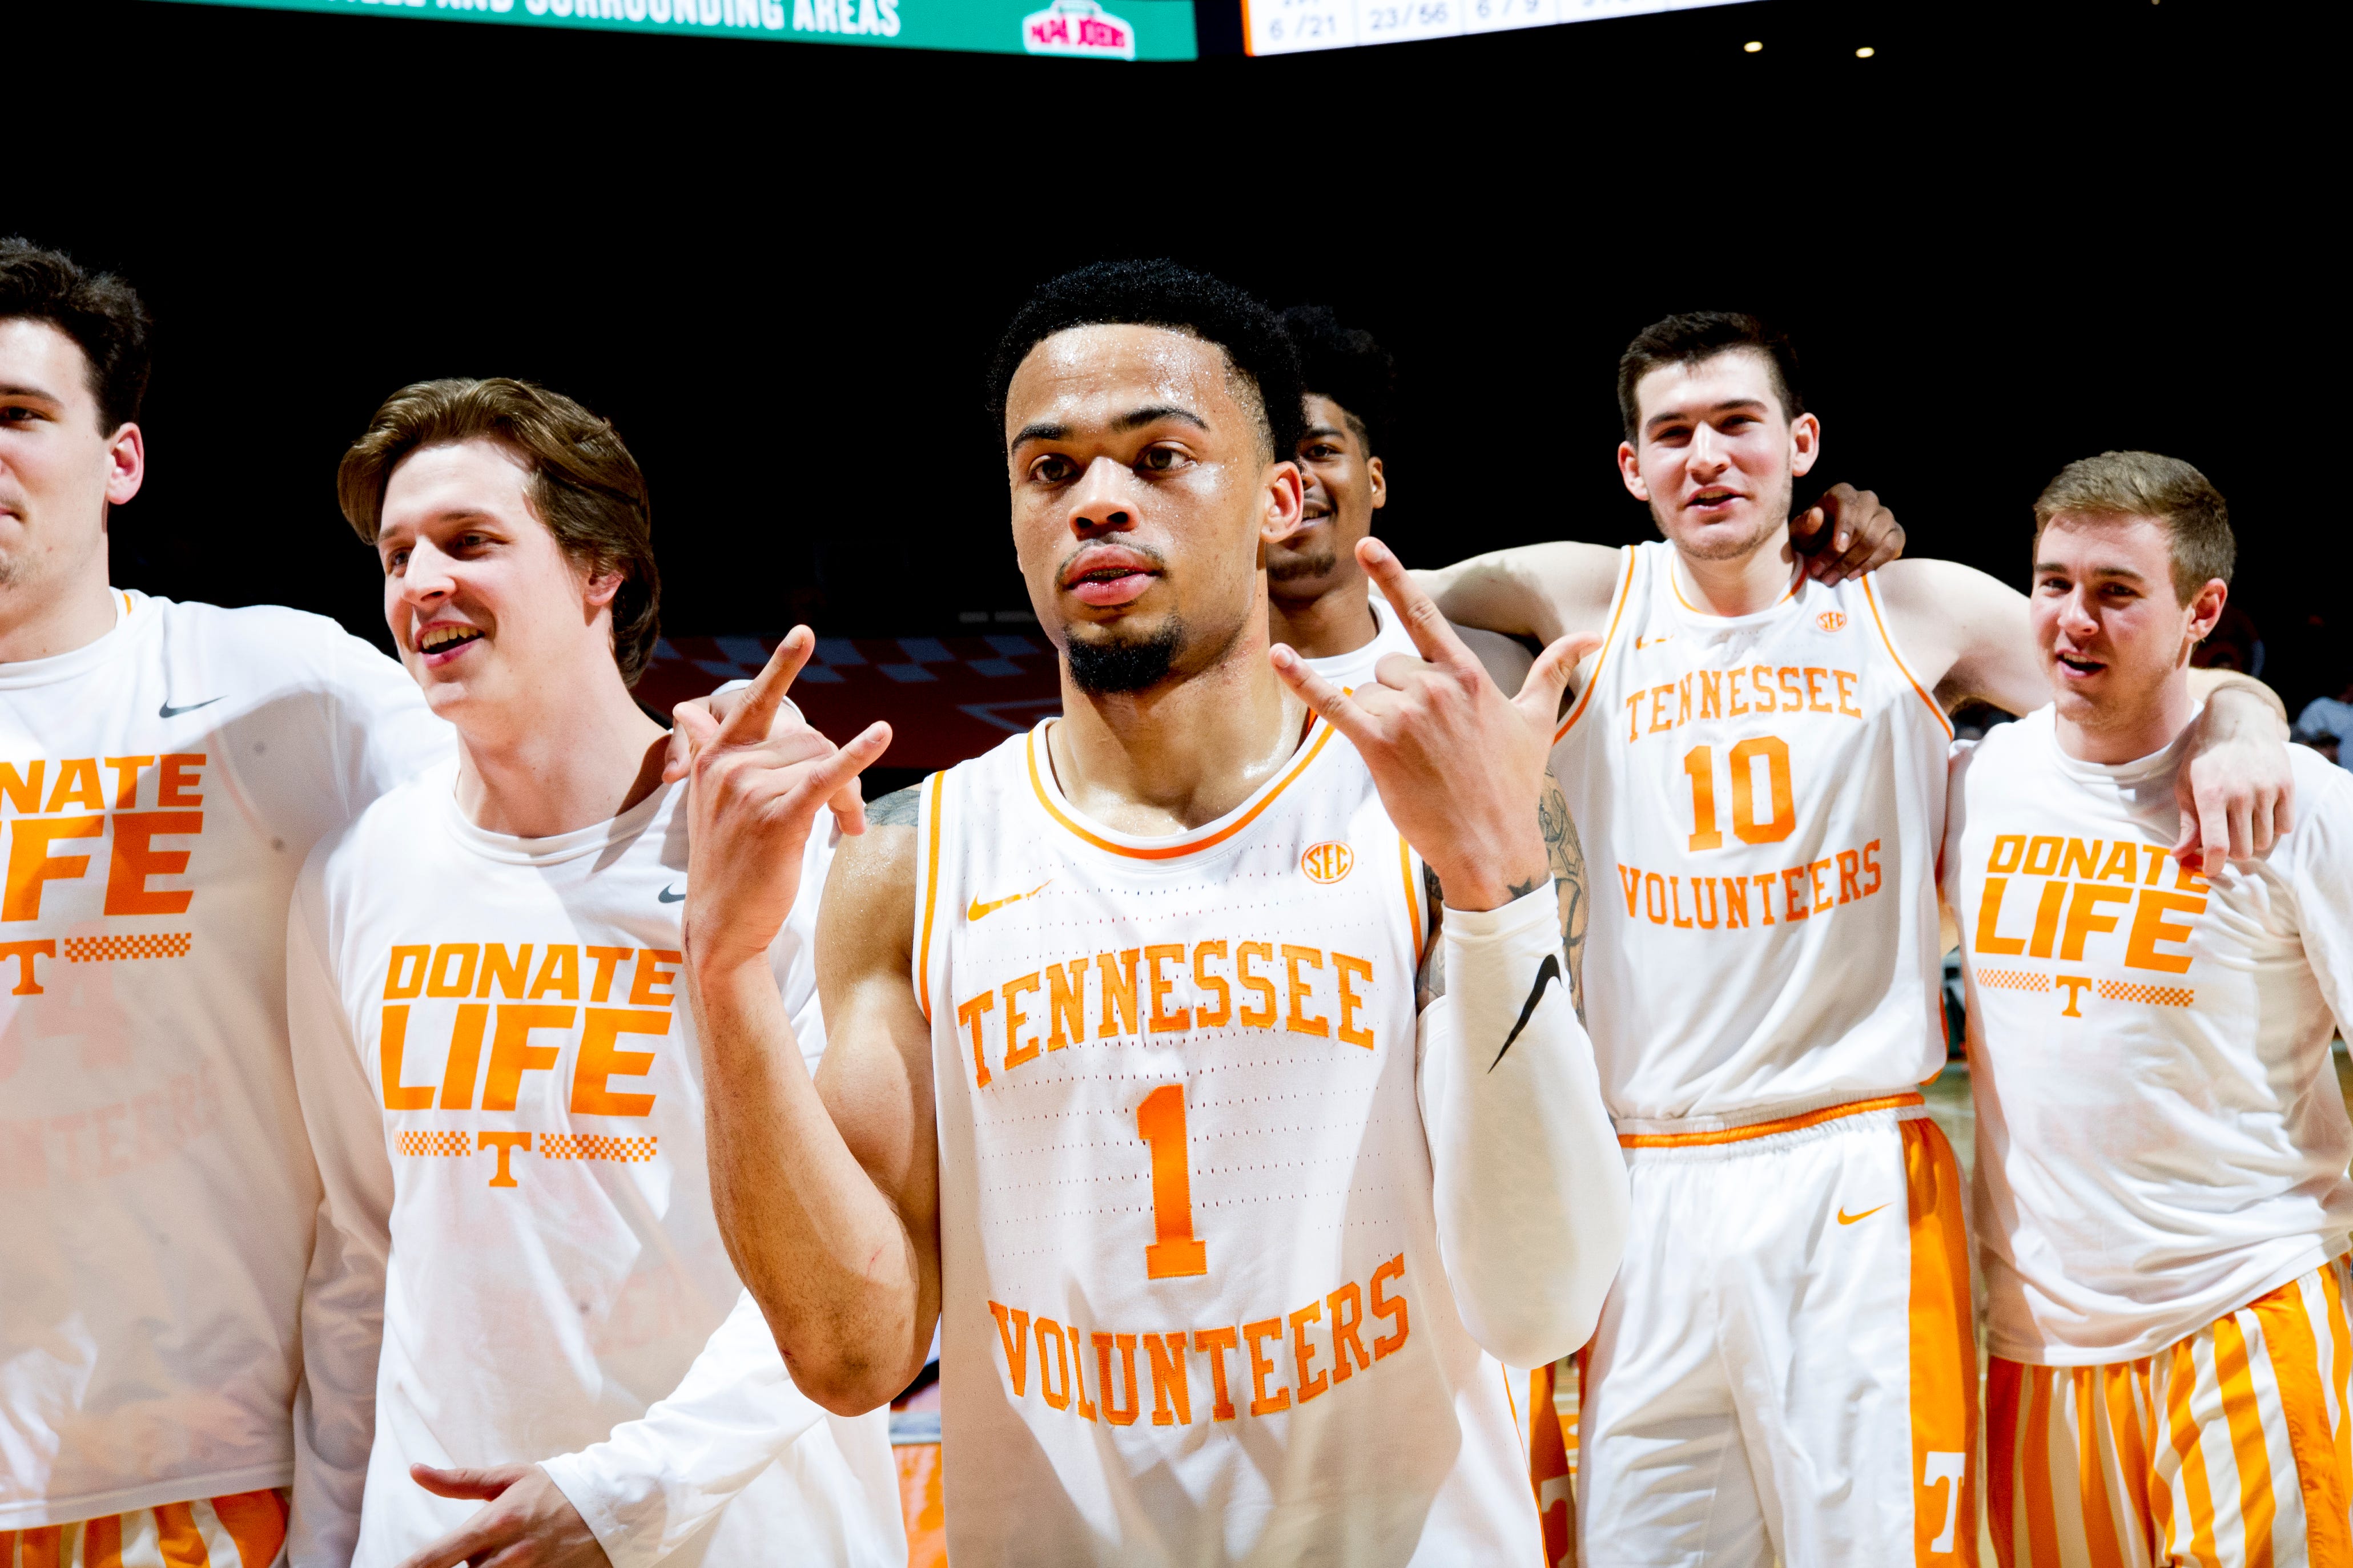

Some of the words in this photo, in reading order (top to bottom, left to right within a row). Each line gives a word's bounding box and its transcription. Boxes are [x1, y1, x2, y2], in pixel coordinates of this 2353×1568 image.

[792, 0, 901, 38] AREAS
[1819, 612, 1844, 630] SEC
[1626, 664, 1863, 744] TENNESSEE
[1684, 735, 1796, 852] 10
[0, 811, 204, 922] FE
[1307, 844, 1348, 880] SEC
[1618, 839, 1883, 930] VOLUNTEERS
[1986, 835, 2211, 894] DONATE
[1975, 877, 2208, 974] LIFE
[383, 943, 683, 1006] DONATE
[958, 940, 1374, 1089] TENNESSEE
[2056, 975, 2092, 1018] T
[380, 1003, 673, 1117] LIFE
[477, 1131, 532, 1188] T
[1136, 1083, 1208, 1279] 1
[988, 1252, 1410, 1426] VOLUNTEERS
